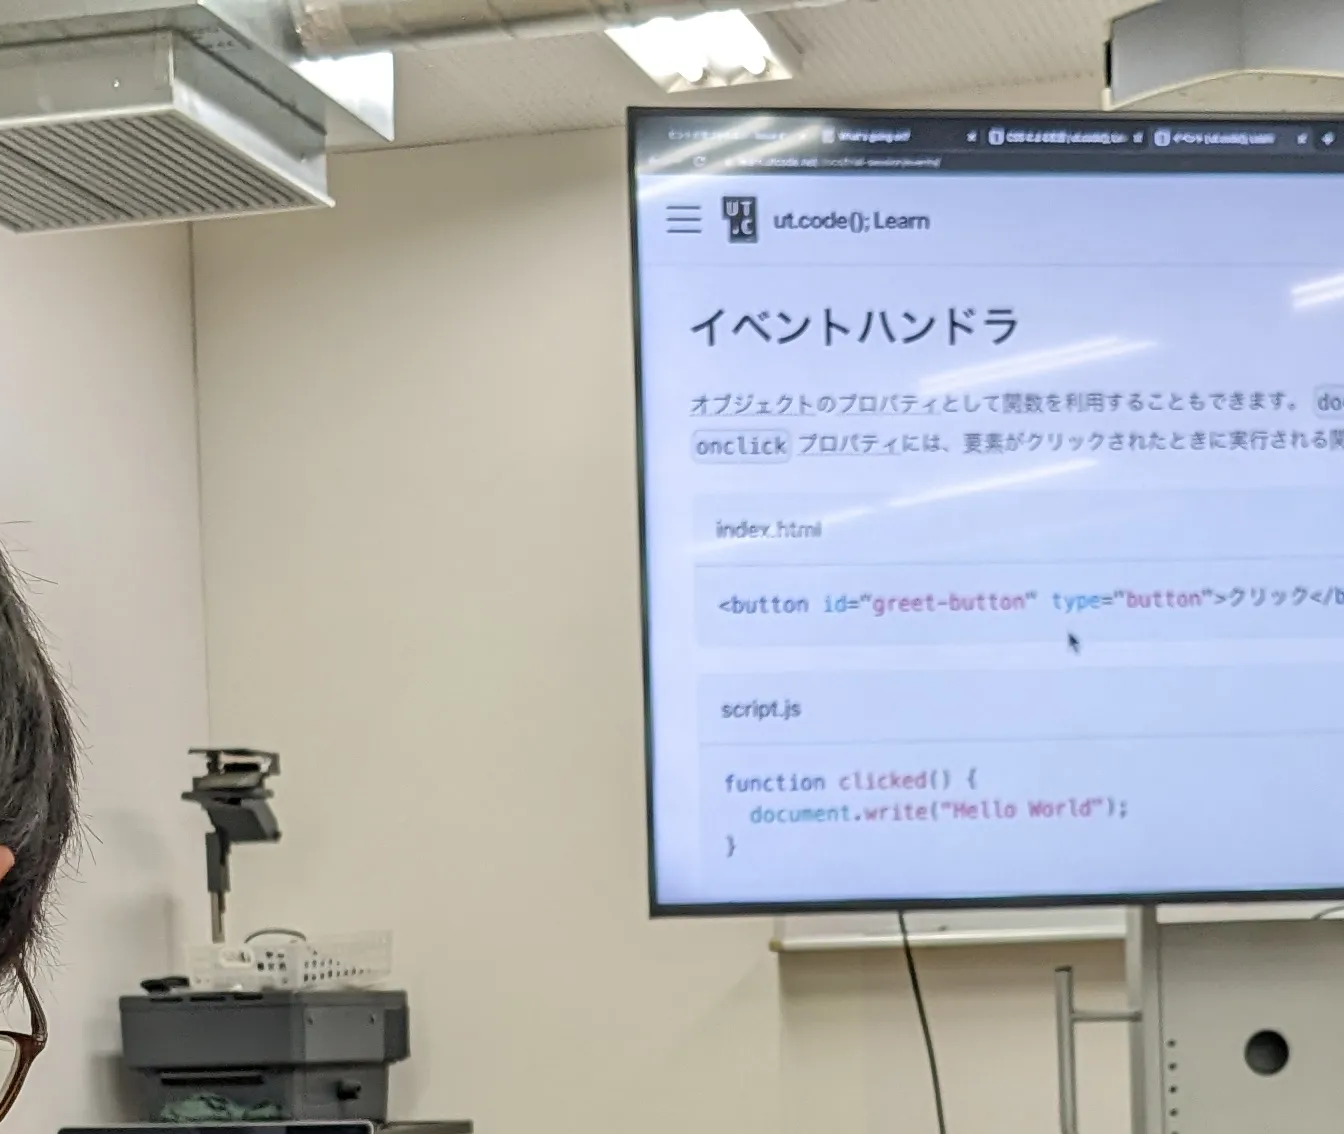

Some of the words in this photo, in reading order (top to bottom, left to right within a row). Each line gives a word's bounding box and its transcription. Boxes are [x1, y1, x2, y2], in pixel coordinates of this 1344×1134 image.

[725, 200, 753, 216] UT
[773, 211, 870, 233] ut.code();
[874, 212, 931, 230] Learn
[690, 306, 1019, 347] イベントハンドラ
[695, 434, 787, 456] onclick
[715, 518, 823, 541] index.html
[717, 594, 809, 616] <button
[823, 589, 1037, 617] id="greet-button"
[721, 697, 802, 722] script.js
[724, 771, 826, 794] function
[838, 769, 952, 793] clicked()
[749, 797, 1017, 825] document.write("Hello
[1027, 795, 1130, 821] World");
[725, 832, 737, 858] }
